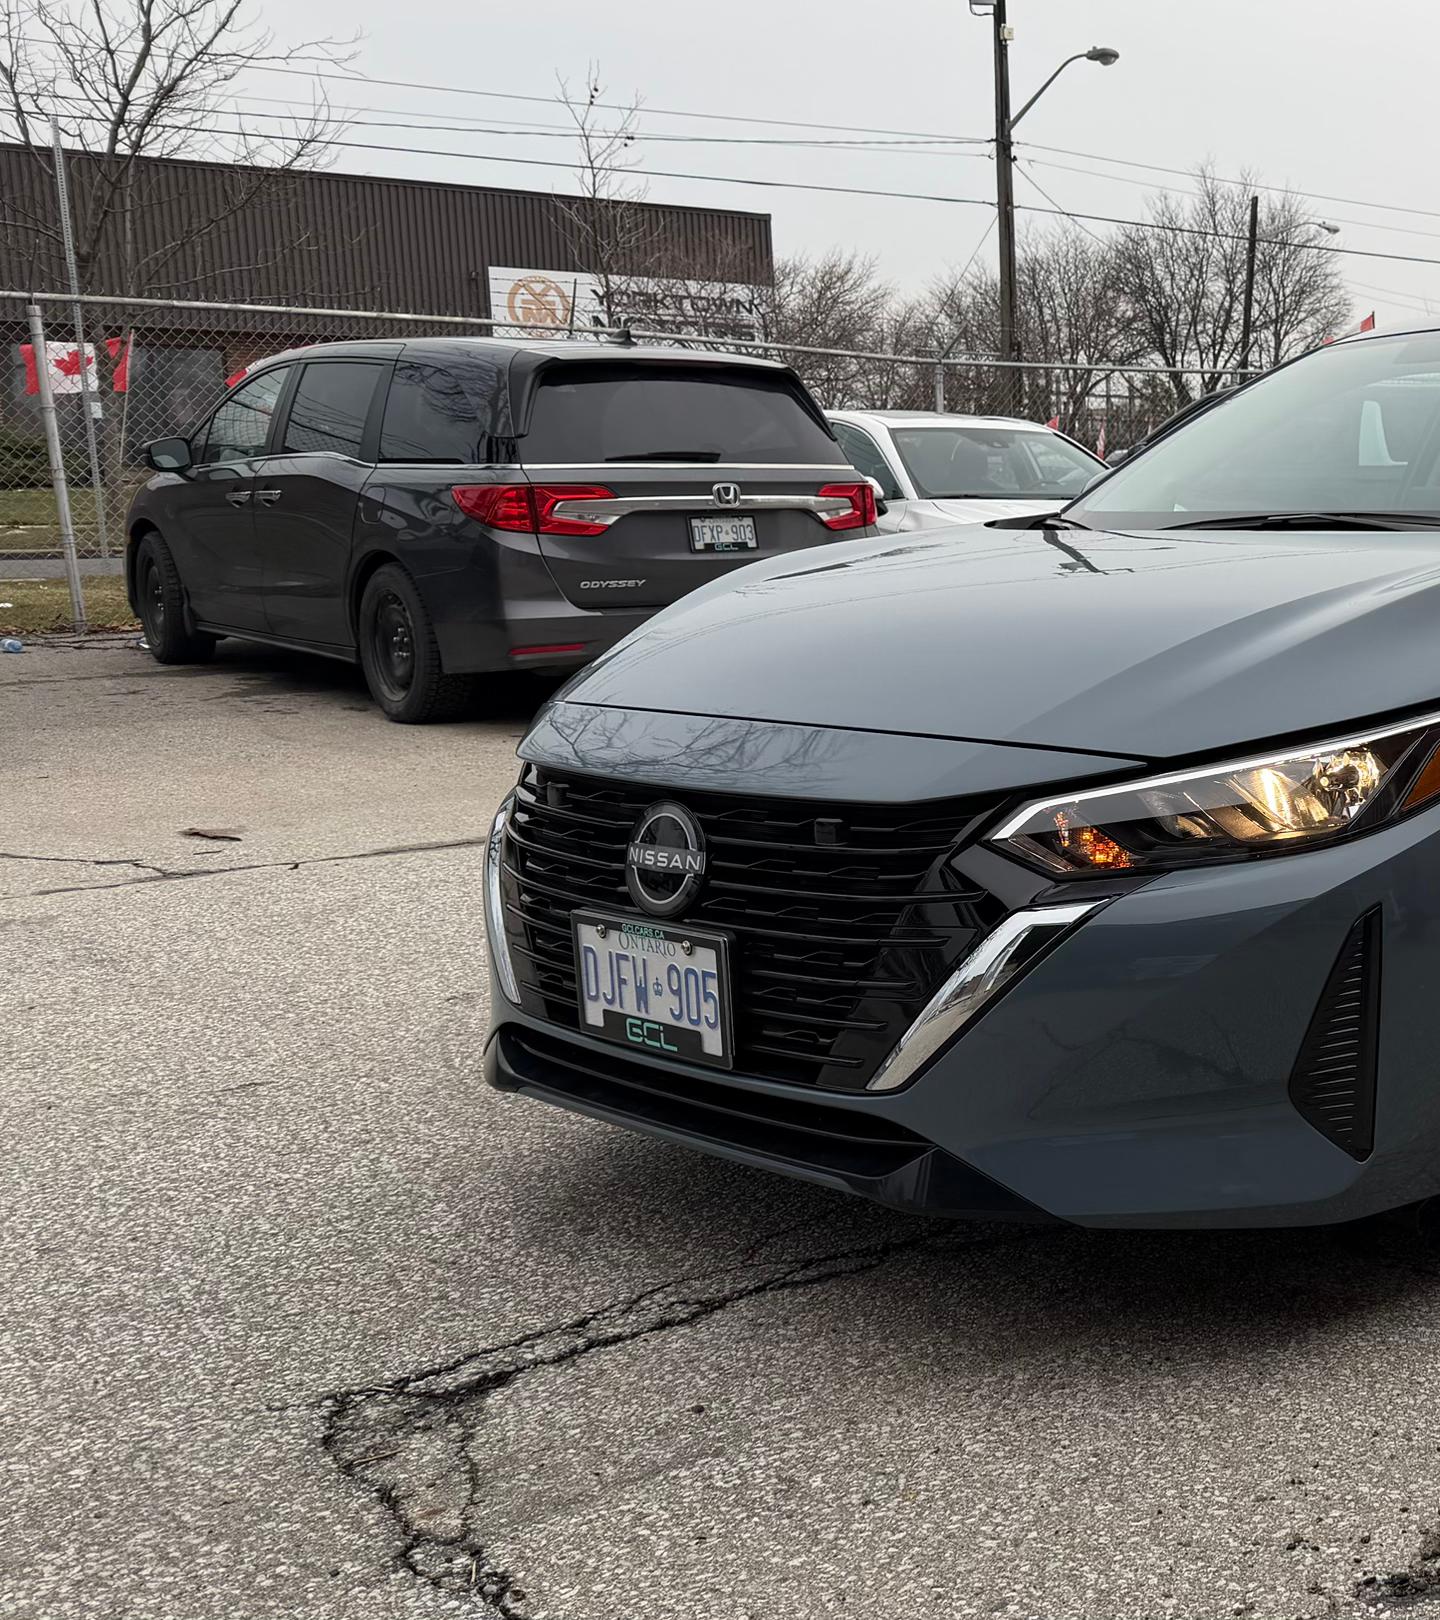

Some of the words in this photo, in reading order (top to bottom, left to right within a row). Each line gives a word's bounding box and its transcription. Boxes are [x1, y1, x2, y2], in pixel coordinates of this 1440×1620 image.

[694, 525, 723, 542] DFXP
[730, 524, 754, 541] 903
[580, 579, 646, 589] ODYSSEY
[629, 846, 701, 871] NISSAN
[618, 932, 676, 960] ONTARIO
[583, 945, 649, 1014] DJFW
[667, 963, 719, 1030] 905
